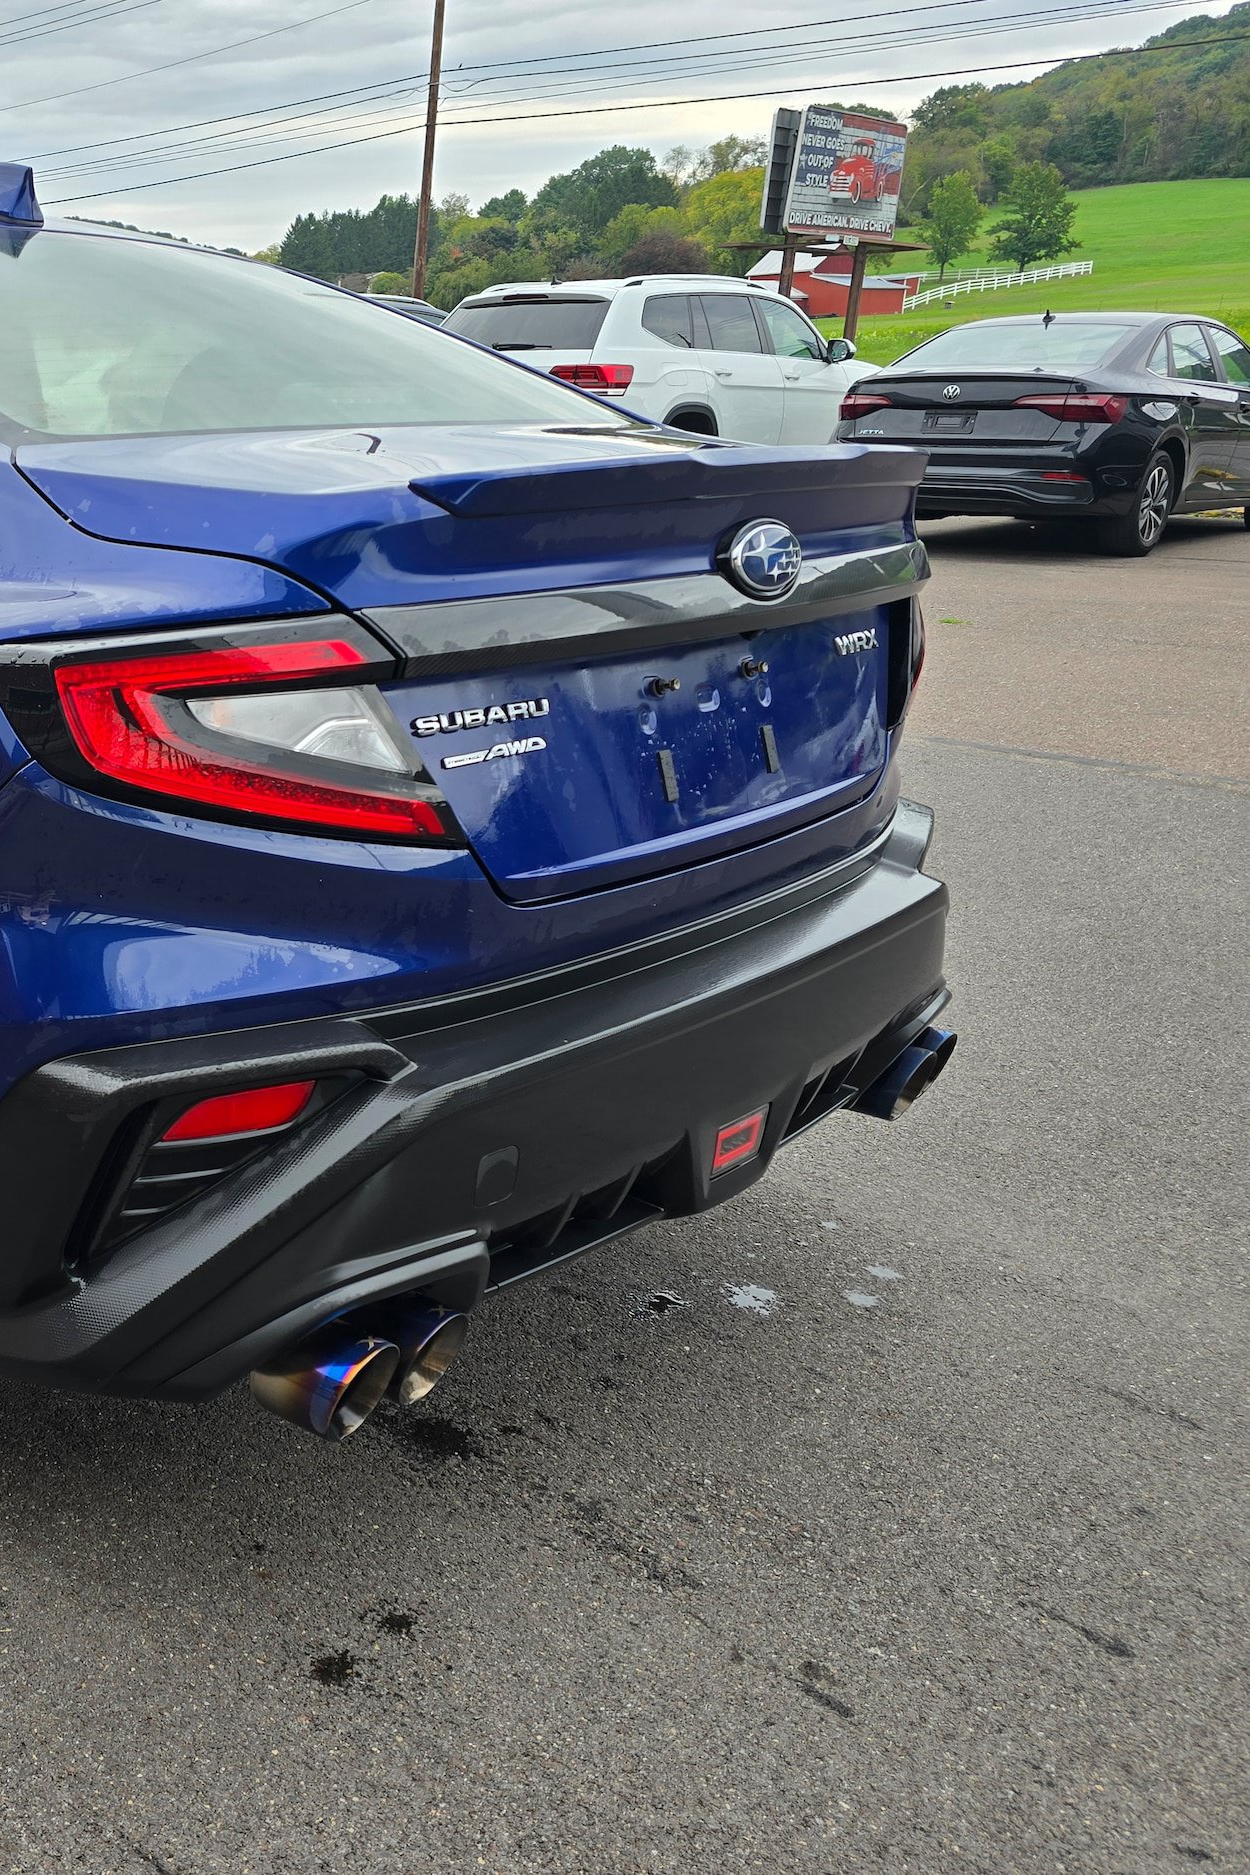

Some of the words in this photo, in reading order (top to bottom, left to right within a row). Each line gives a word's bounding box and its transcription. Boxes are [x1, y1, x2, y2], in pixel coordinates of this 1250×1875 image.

[810, 114, 843, 130] FREEDOM
[802, 132, 825, 148] NEVER
[826, 136, 845, 151] GOES
[789, 211, 812, 225] DRIVE
[849, 217, 869, 231] DRIVE
[834, 627, 879, 656] WRX
[412, 698, 550, 737] SUBARU
[485, 736, 547, 760] AWD
